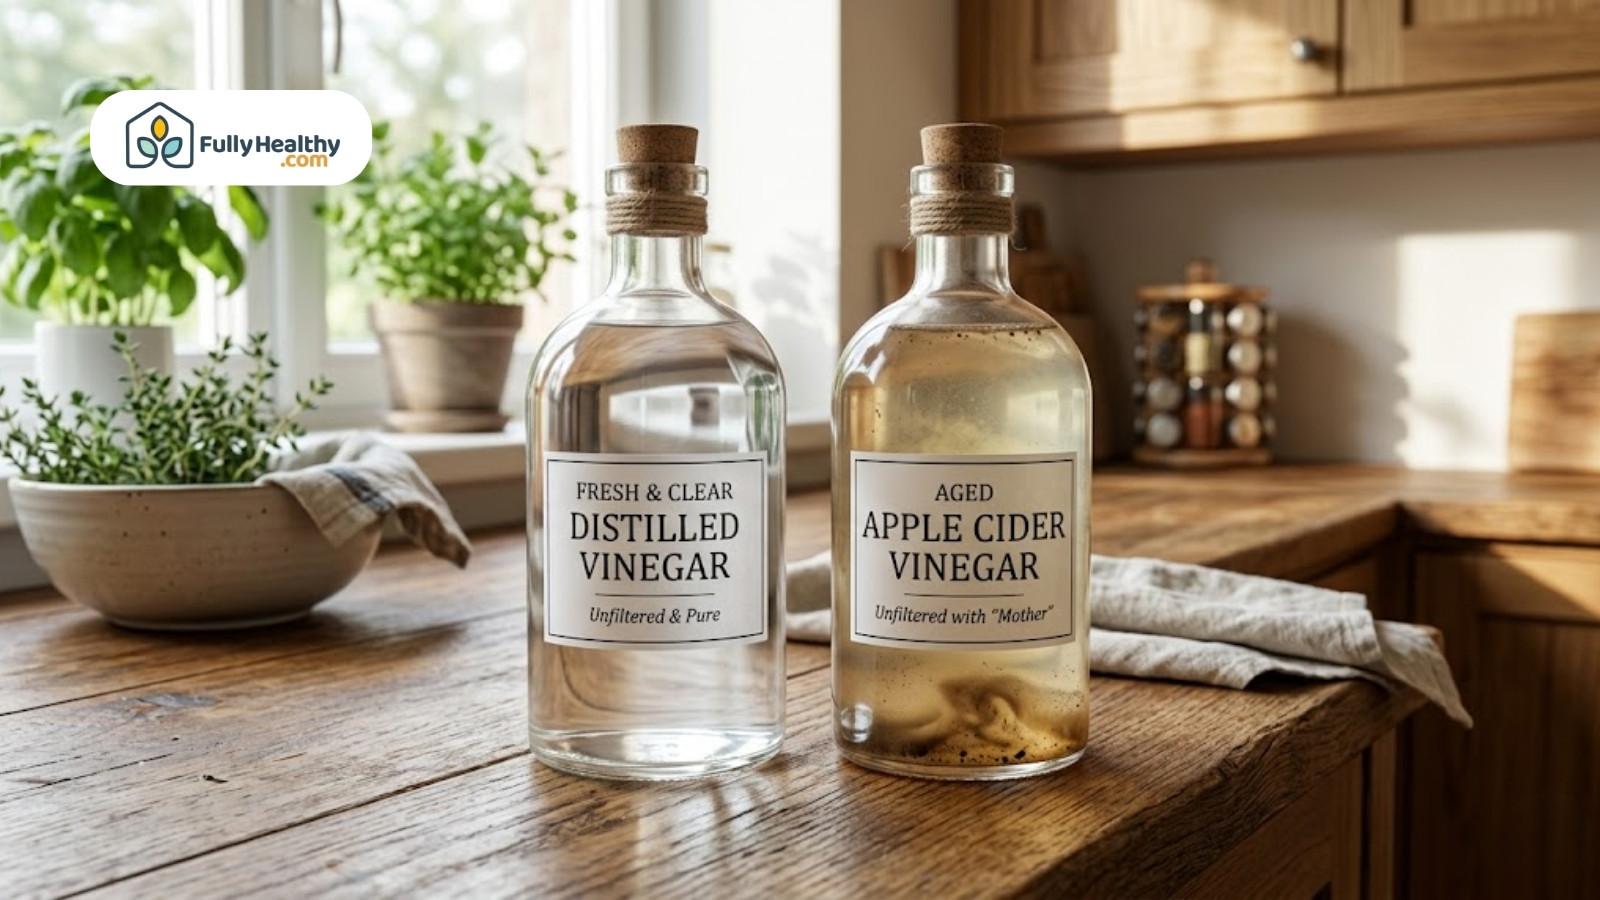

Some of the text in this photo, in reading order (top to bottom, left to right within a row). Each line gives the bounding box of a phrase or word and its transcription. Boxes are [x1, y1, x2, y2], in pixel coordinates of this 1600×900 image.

[576, 482, 734, 501] FRESH & CLEAR
[934, 483, 994, 502] AGED
[570, 512, 740, 542] DISTILLED
[862, 511, 1066, 542] APPLE CIDER
[580, 551, 730, 581] VINEGAR
[889, 551, 1039, 581] VINEGAR
[589, 607, 721, 626] Unfiltered & Pure
[875, 605, 948, 625] Unfiltered
[952, 609, 986, 624] with
